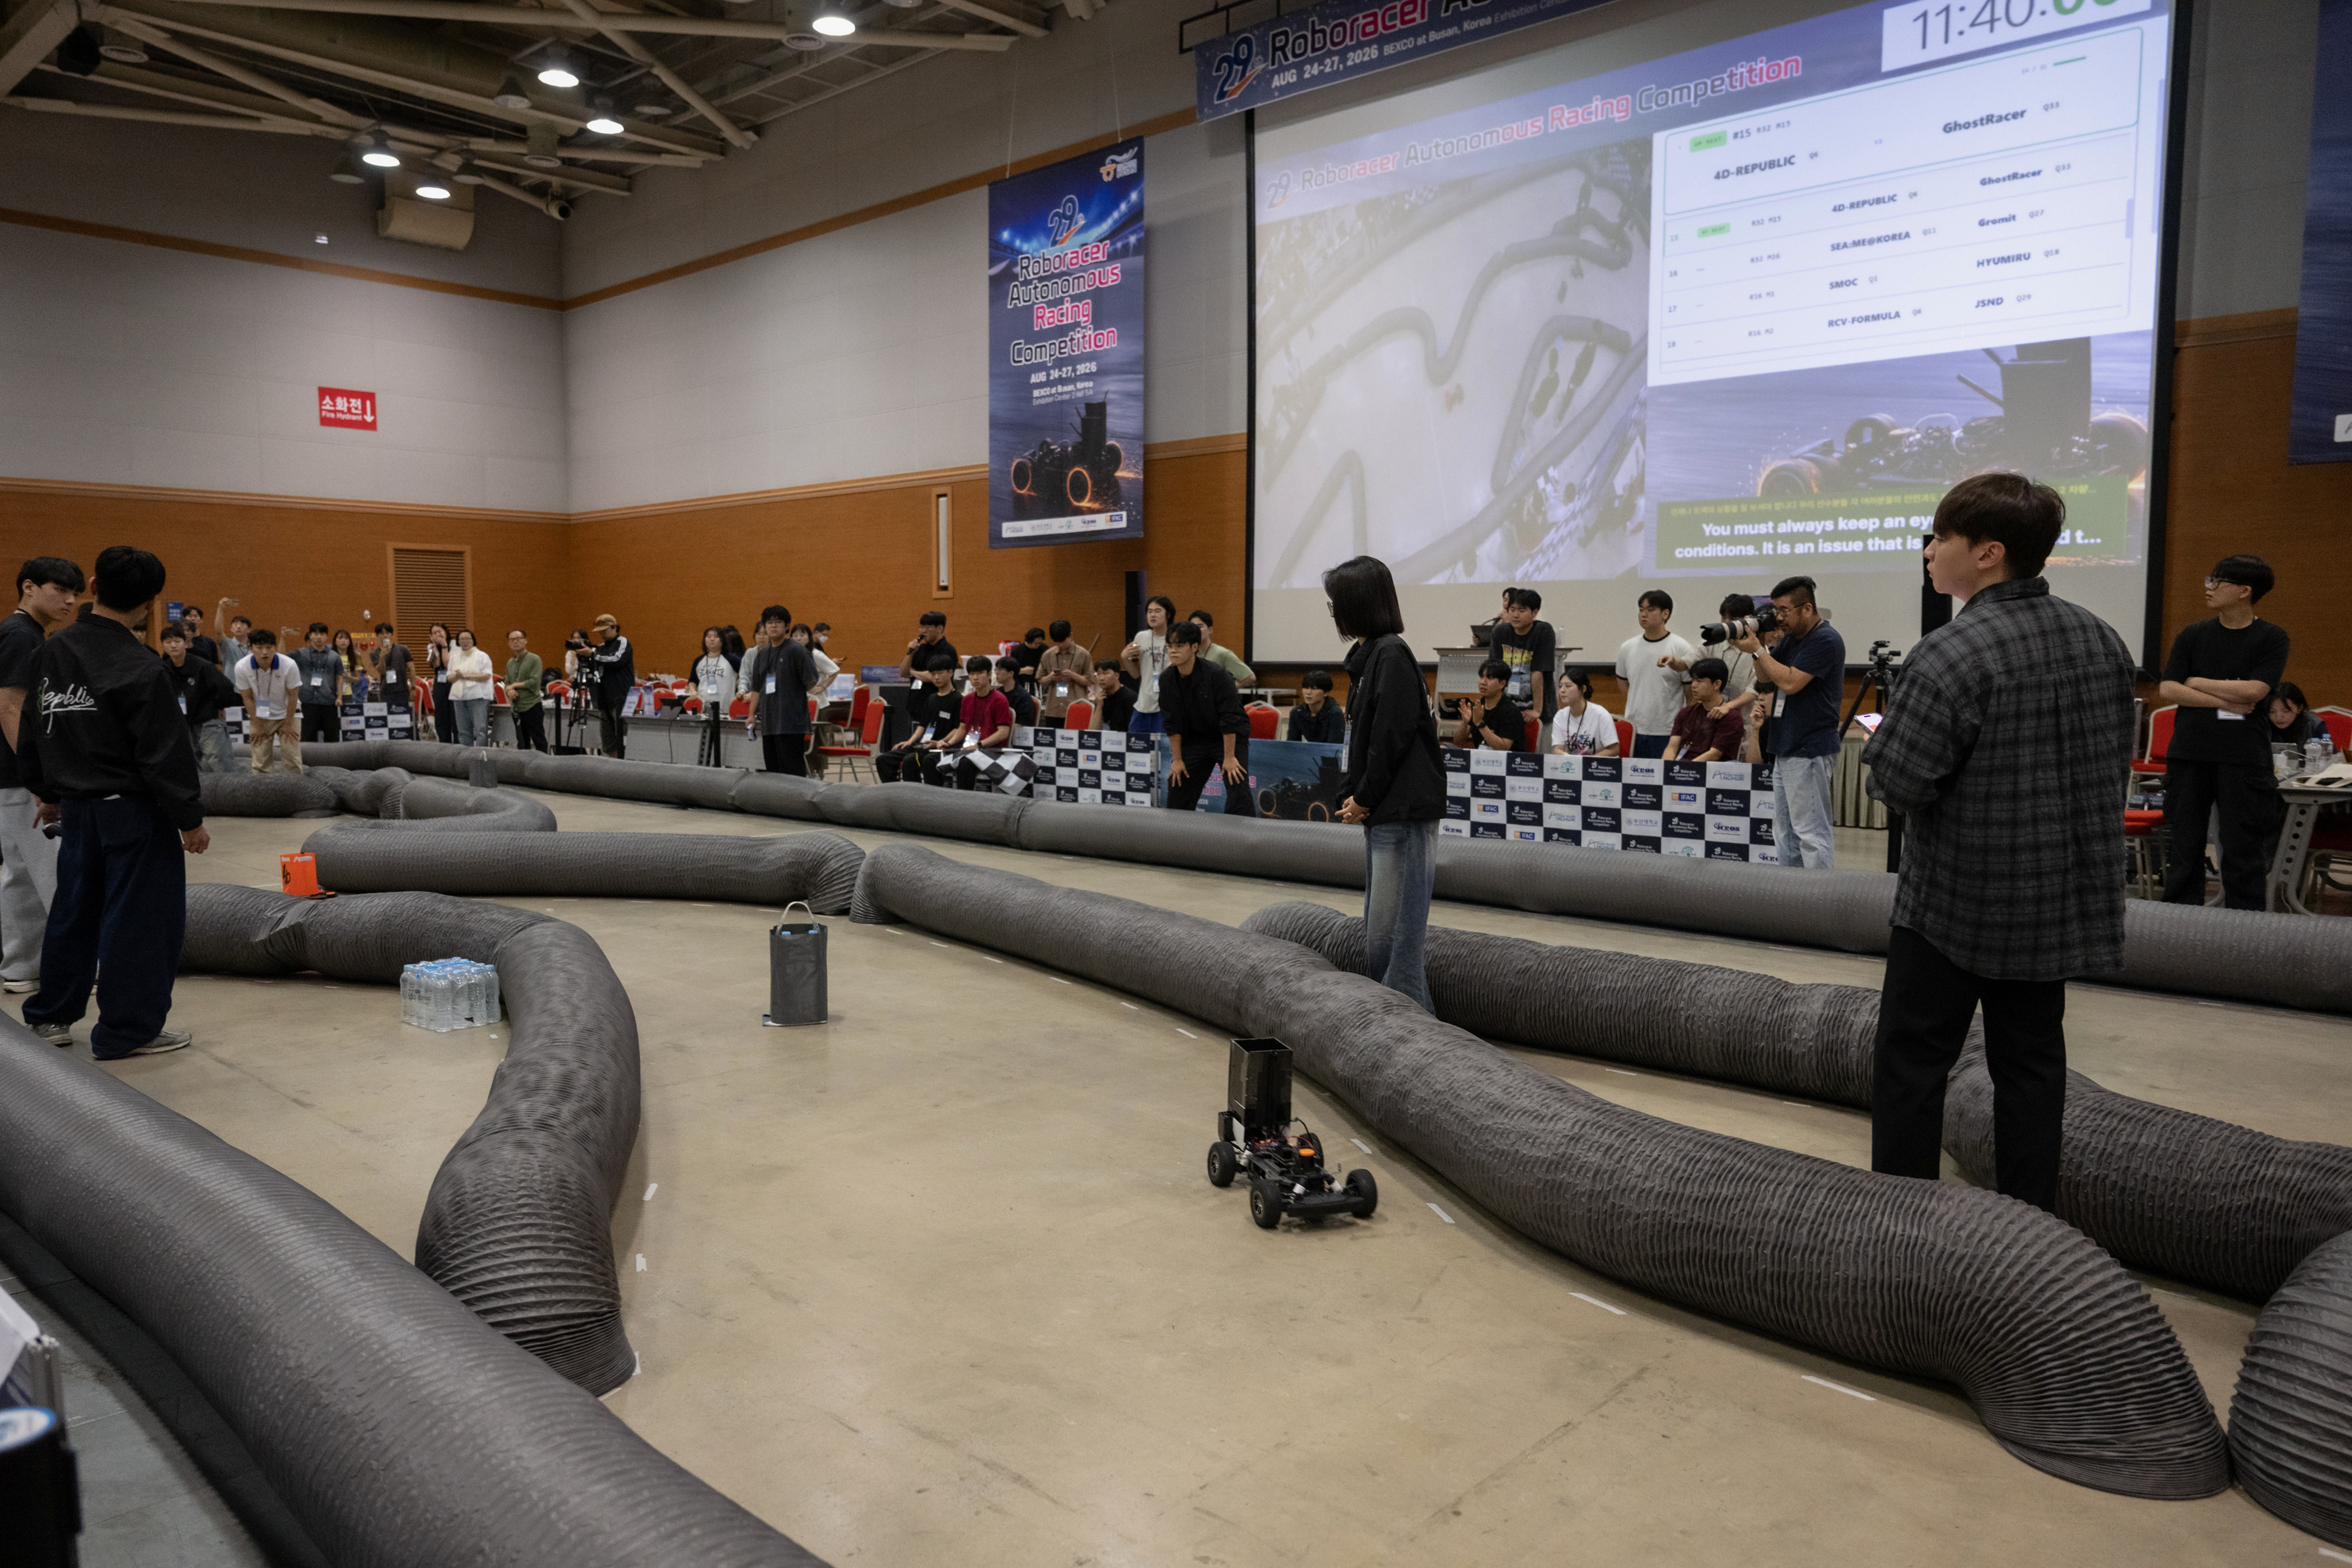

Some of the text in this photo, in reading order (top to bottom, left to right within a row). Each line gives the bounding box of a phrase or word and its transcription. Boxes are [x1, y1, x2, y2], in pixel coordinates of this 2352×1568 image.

[1269, 0, 1429, 69] Roboracer
[1272, 69, 1298, 88] AUG
[1303, 56, 1343, 79] 24-27,
[1346, 44, 1378, 67] 2026
[1383, 37, 1415, 56] BEXCO
[1416, 35, 1427, 46] at
[1429, 26, 1460, 43] Busan,
[1463, 16, 1492, 32] Korea
[1300, 152, 1400, 192] Roboracer
[1403, 117, 1543, 167] Autonomous
[1547, 94, 1631, 133] Racing
[1636, 55, 1802, 112] Competition
[1733, 128, 1752, 141] #15
[1713, 155, 1796, 181] 4D-REPUBLIC
[1943, 109, 2027, 134] GhostRacer
[1831, 194, 1898, 213] 4D-REPUBLIC
[1980, 169, 2043, 186] GhostRacer
[1830, 231, 1911, 252] SEA:ME@KOREA
[1977, 213, 2017, 227] Gromit
[1019, 240, 1110, 281] Roboracer
[1829, 278, 1858, 290] SMOC
[1976, 252, 2031, 268] HYUMIRU
[1007, 264, 1121, 309] Autonomous
[1034, 297, 1092, 330] Racing
[1827, 311, 1901, 328] RCV-FORMULA
[1975, 297, 2004, 309] JSND
[1011, 325, 1117, 366] Competition
[1030, 362, 1097, 384] AUG 24-27, 2026
[321, 395, 362, 414] 소화전
[1702, 522, 1731, 536] You
[1734, 521, 1774, 535] must
[1777, 519, 1835, 535] always
[1837, 516, 1880, 533] keep
[1883, 516, 1906, 529] an
[1674, 535, 1922, 558] conditions. It is an issue that is
